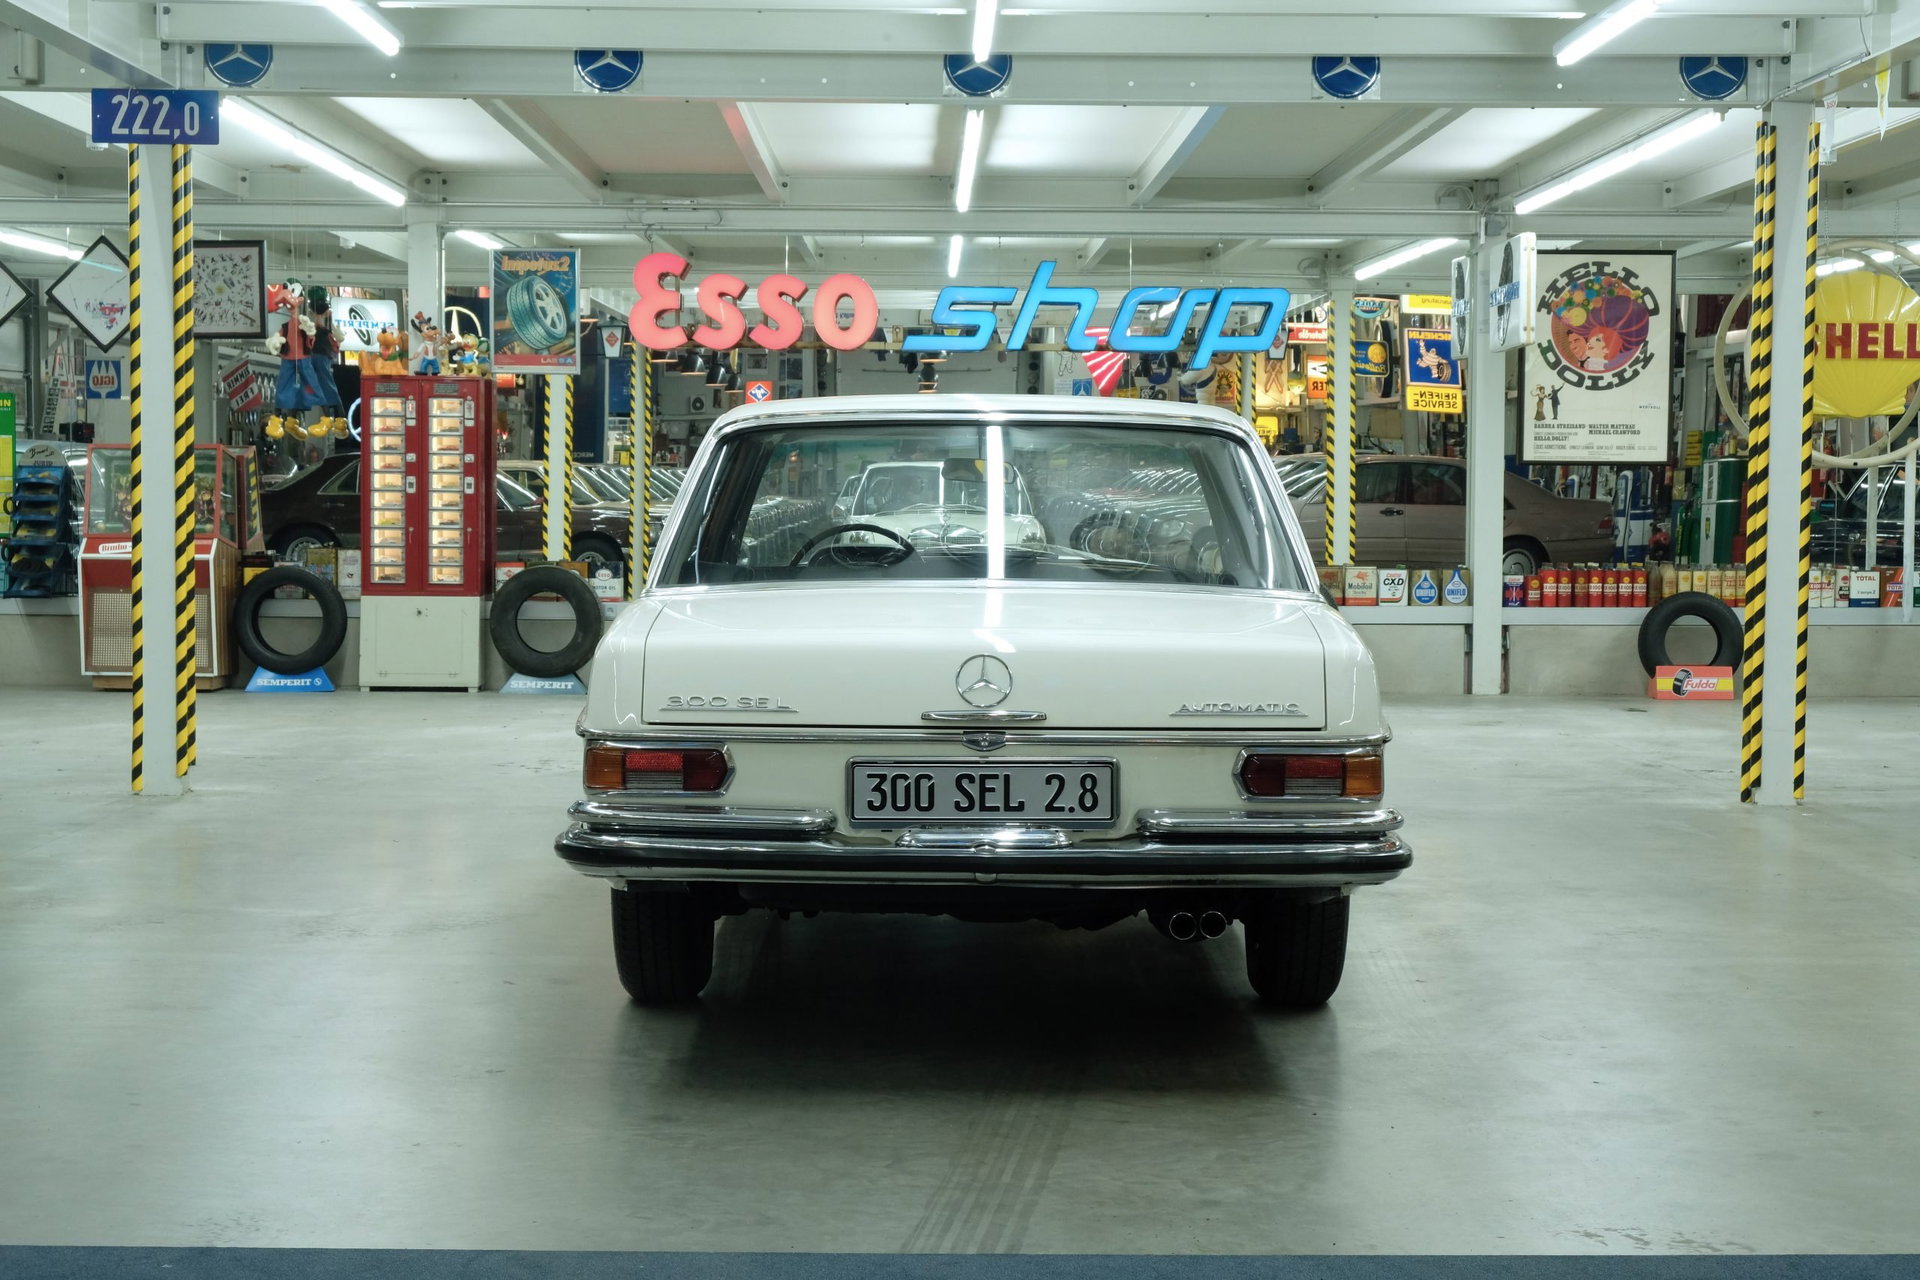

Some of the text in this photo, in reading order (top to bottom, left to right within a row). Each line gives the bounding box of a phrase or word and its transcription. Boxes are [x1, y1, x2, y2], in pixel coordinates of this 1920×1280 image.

[111, 94, 200, 140] 222,0
[1537, 261, 1660, 317] HELLO
[628, 252, 1291, 371] Esso shop
[1814, 322, 1920, 359] HELL
[1537, 339, 1655, 391] DOLLY
[1383, 578, 1404, 586] CXD
[1446, 588, 1466, 596] UNIFLO
[257, 678, 313, 687] SEMPERIT
[510, 680, 574, 689] SEMPERIT
[1685, 679, 1715, 689] Fulda
[666, 696, 792, 709] 300 SEL
[1179, 702, 1300, 713] AUTOMATIC
[866, 772, 1099, 813] 300 SEL 2.8
